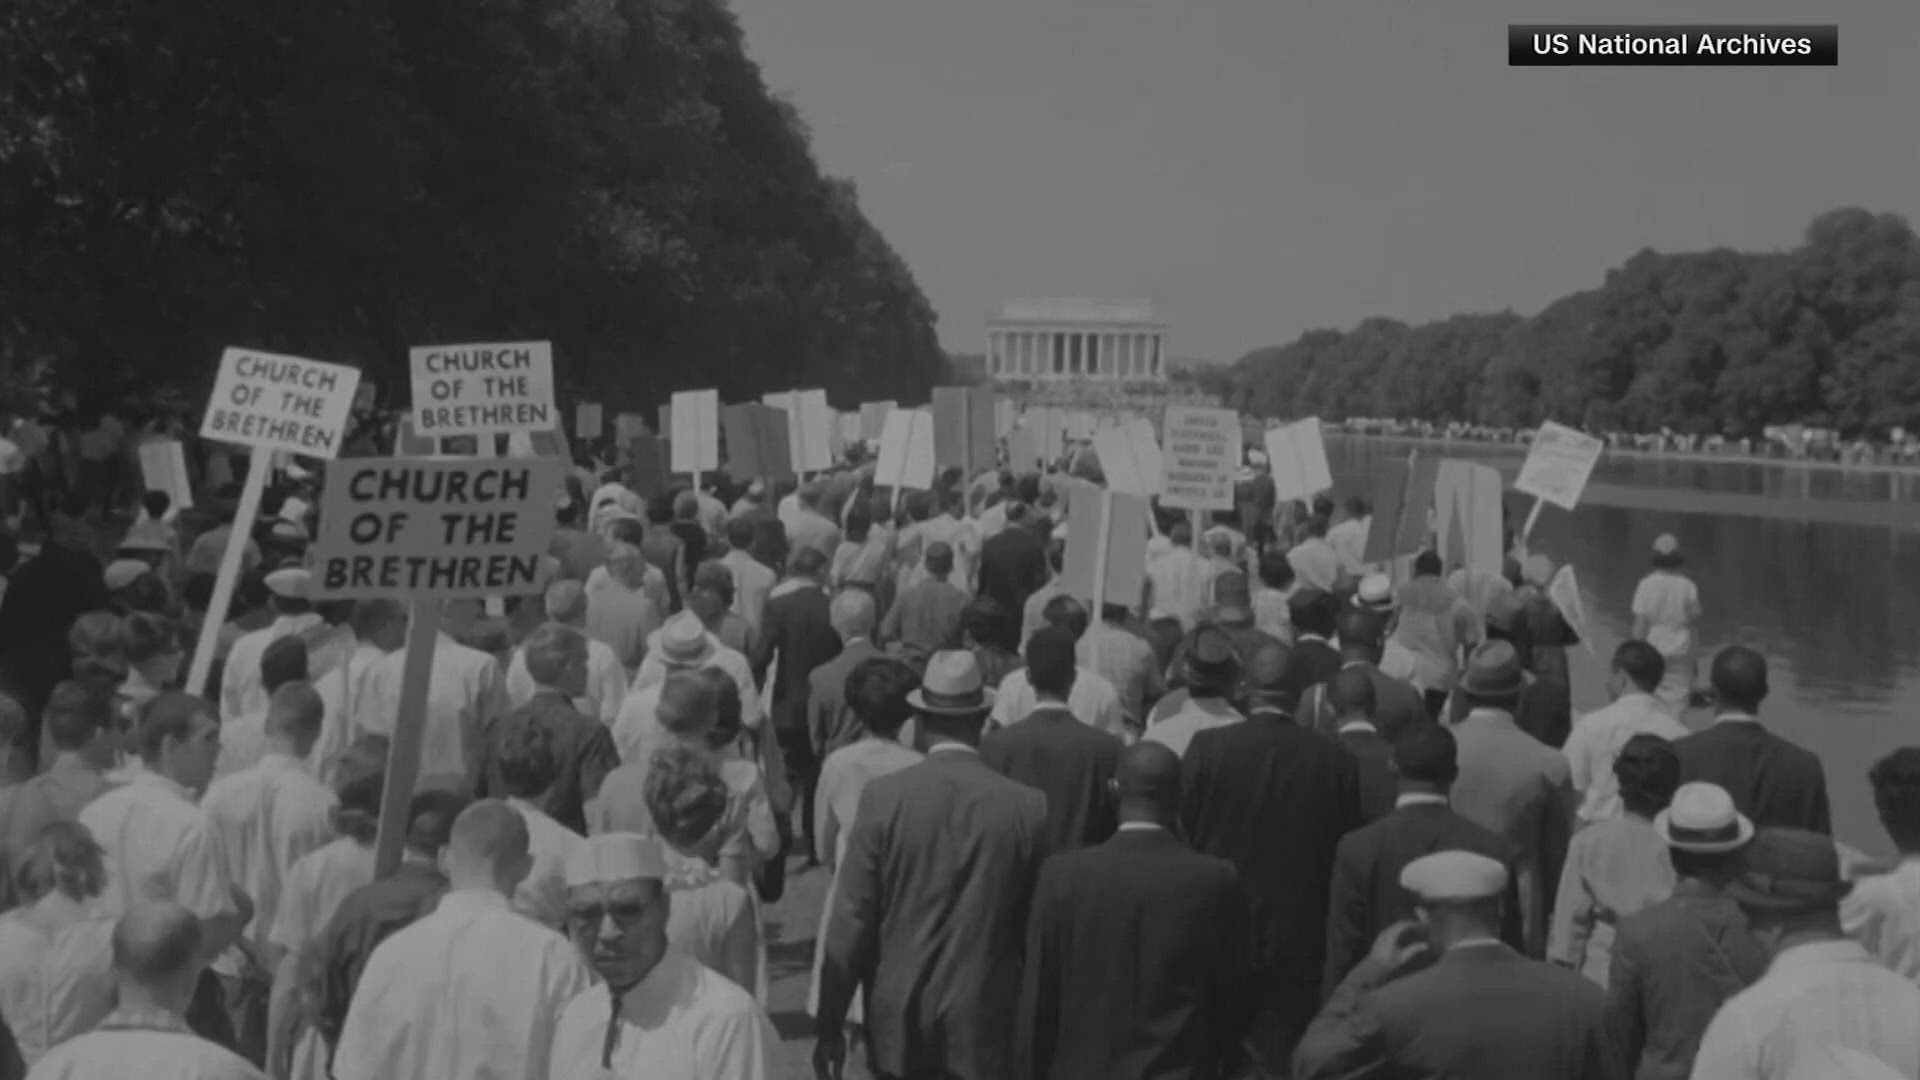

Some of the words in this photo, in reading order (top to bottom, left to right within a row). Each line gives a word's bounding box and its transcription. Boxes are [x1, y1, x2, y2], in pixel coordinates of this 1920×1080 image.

[235, 356, 338, 392] CHURCH
[425, 349, 530, 373] CHURCH
[231, 384, 264, 407] OF
[281, 391, 323, 417] THE
[431, 380, 464, 400] OF
[483, 376, 527, 398] THE
[211, 410, 334, 450] BRETHREN
[421, 403, 547, 428] BRETHREN
[349, 469, 529, 503] CHURCH
[349, 512, 408, 545] OF
[440, 512, 518, 545] THE
[323, 554, 539, 590] BRETHREN
